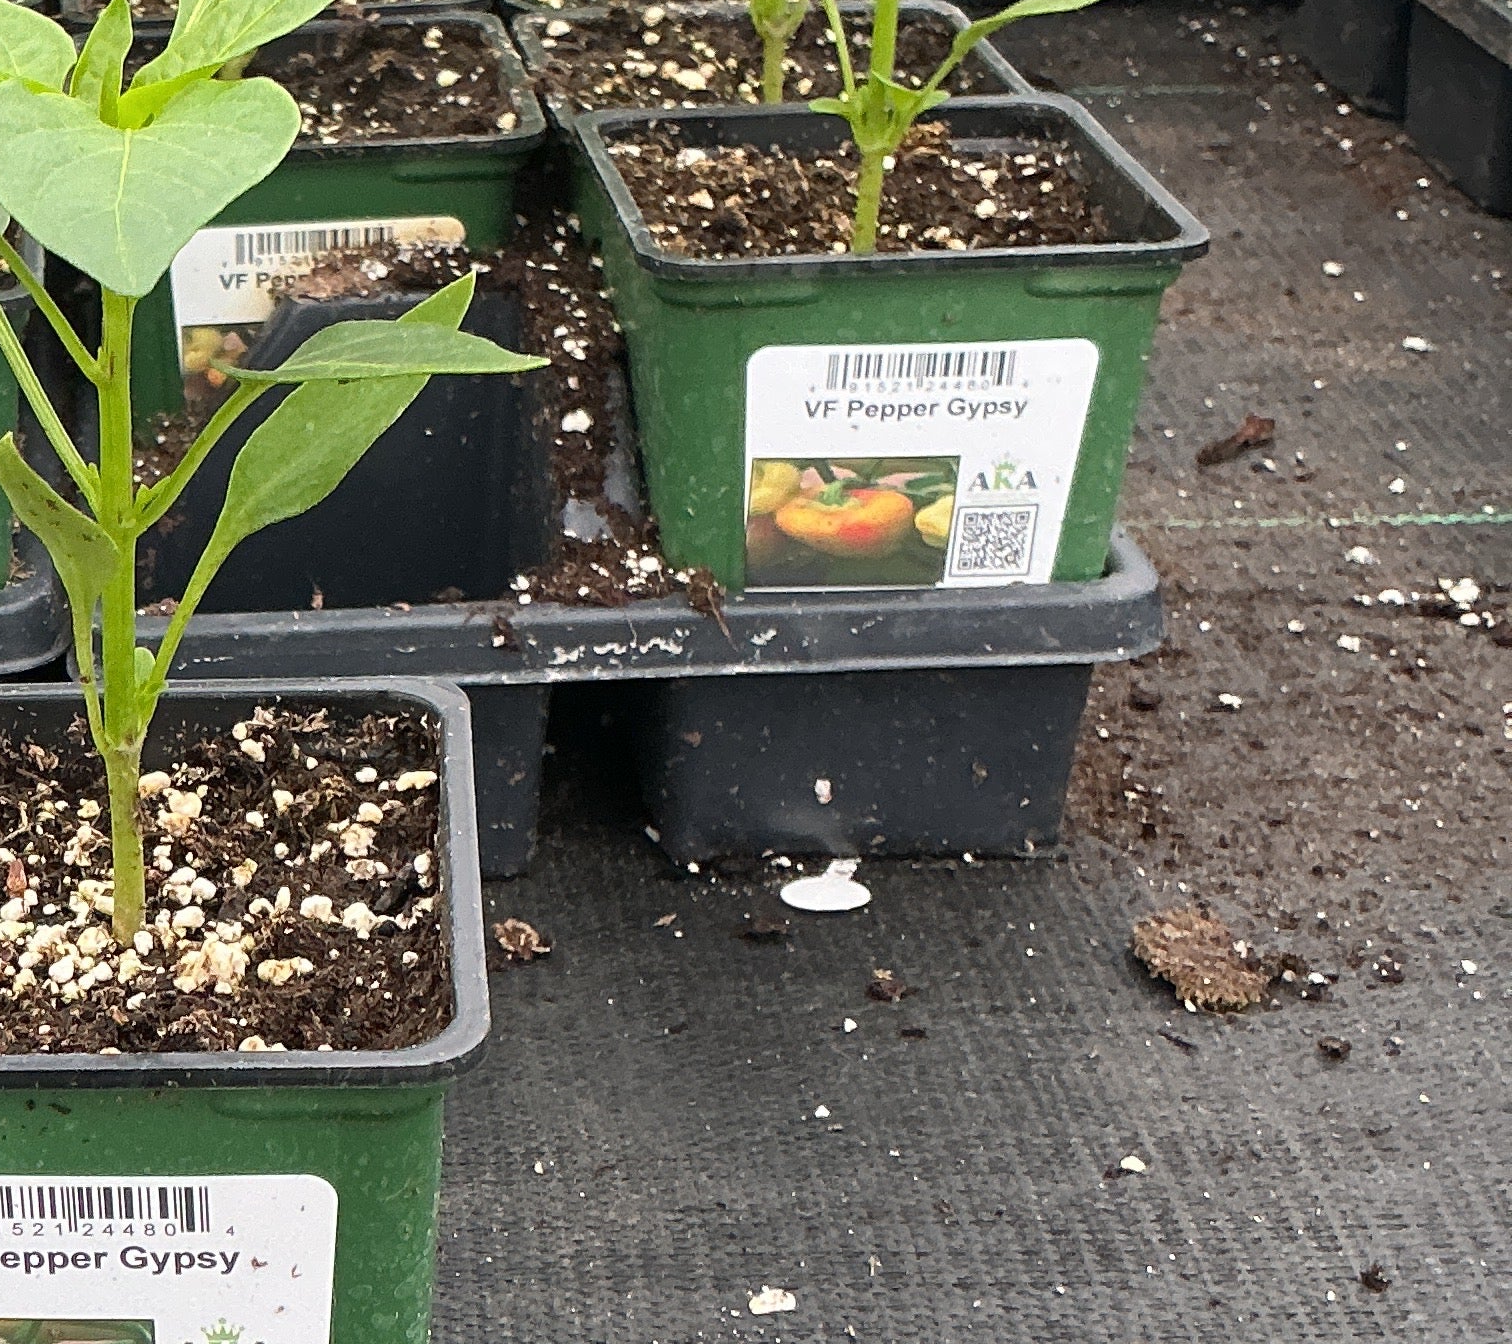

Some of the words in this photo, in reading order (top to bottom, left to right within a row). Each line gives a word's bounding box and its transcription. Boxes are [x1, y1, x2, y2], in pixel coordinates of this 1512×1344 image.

[219, 273, 248, 290] VF
[805, 400, 839, 418] VF
[847, 399, 940, 422] Pepper
[947, 398, 1028, 420] Gypsy
[967, 470, 1037, 491] AKA
[82, 1223, 177, 1237] 24480
[226, 1225, 235, 1237] 4
[120, 1245, 241, 1275] Gypsy
